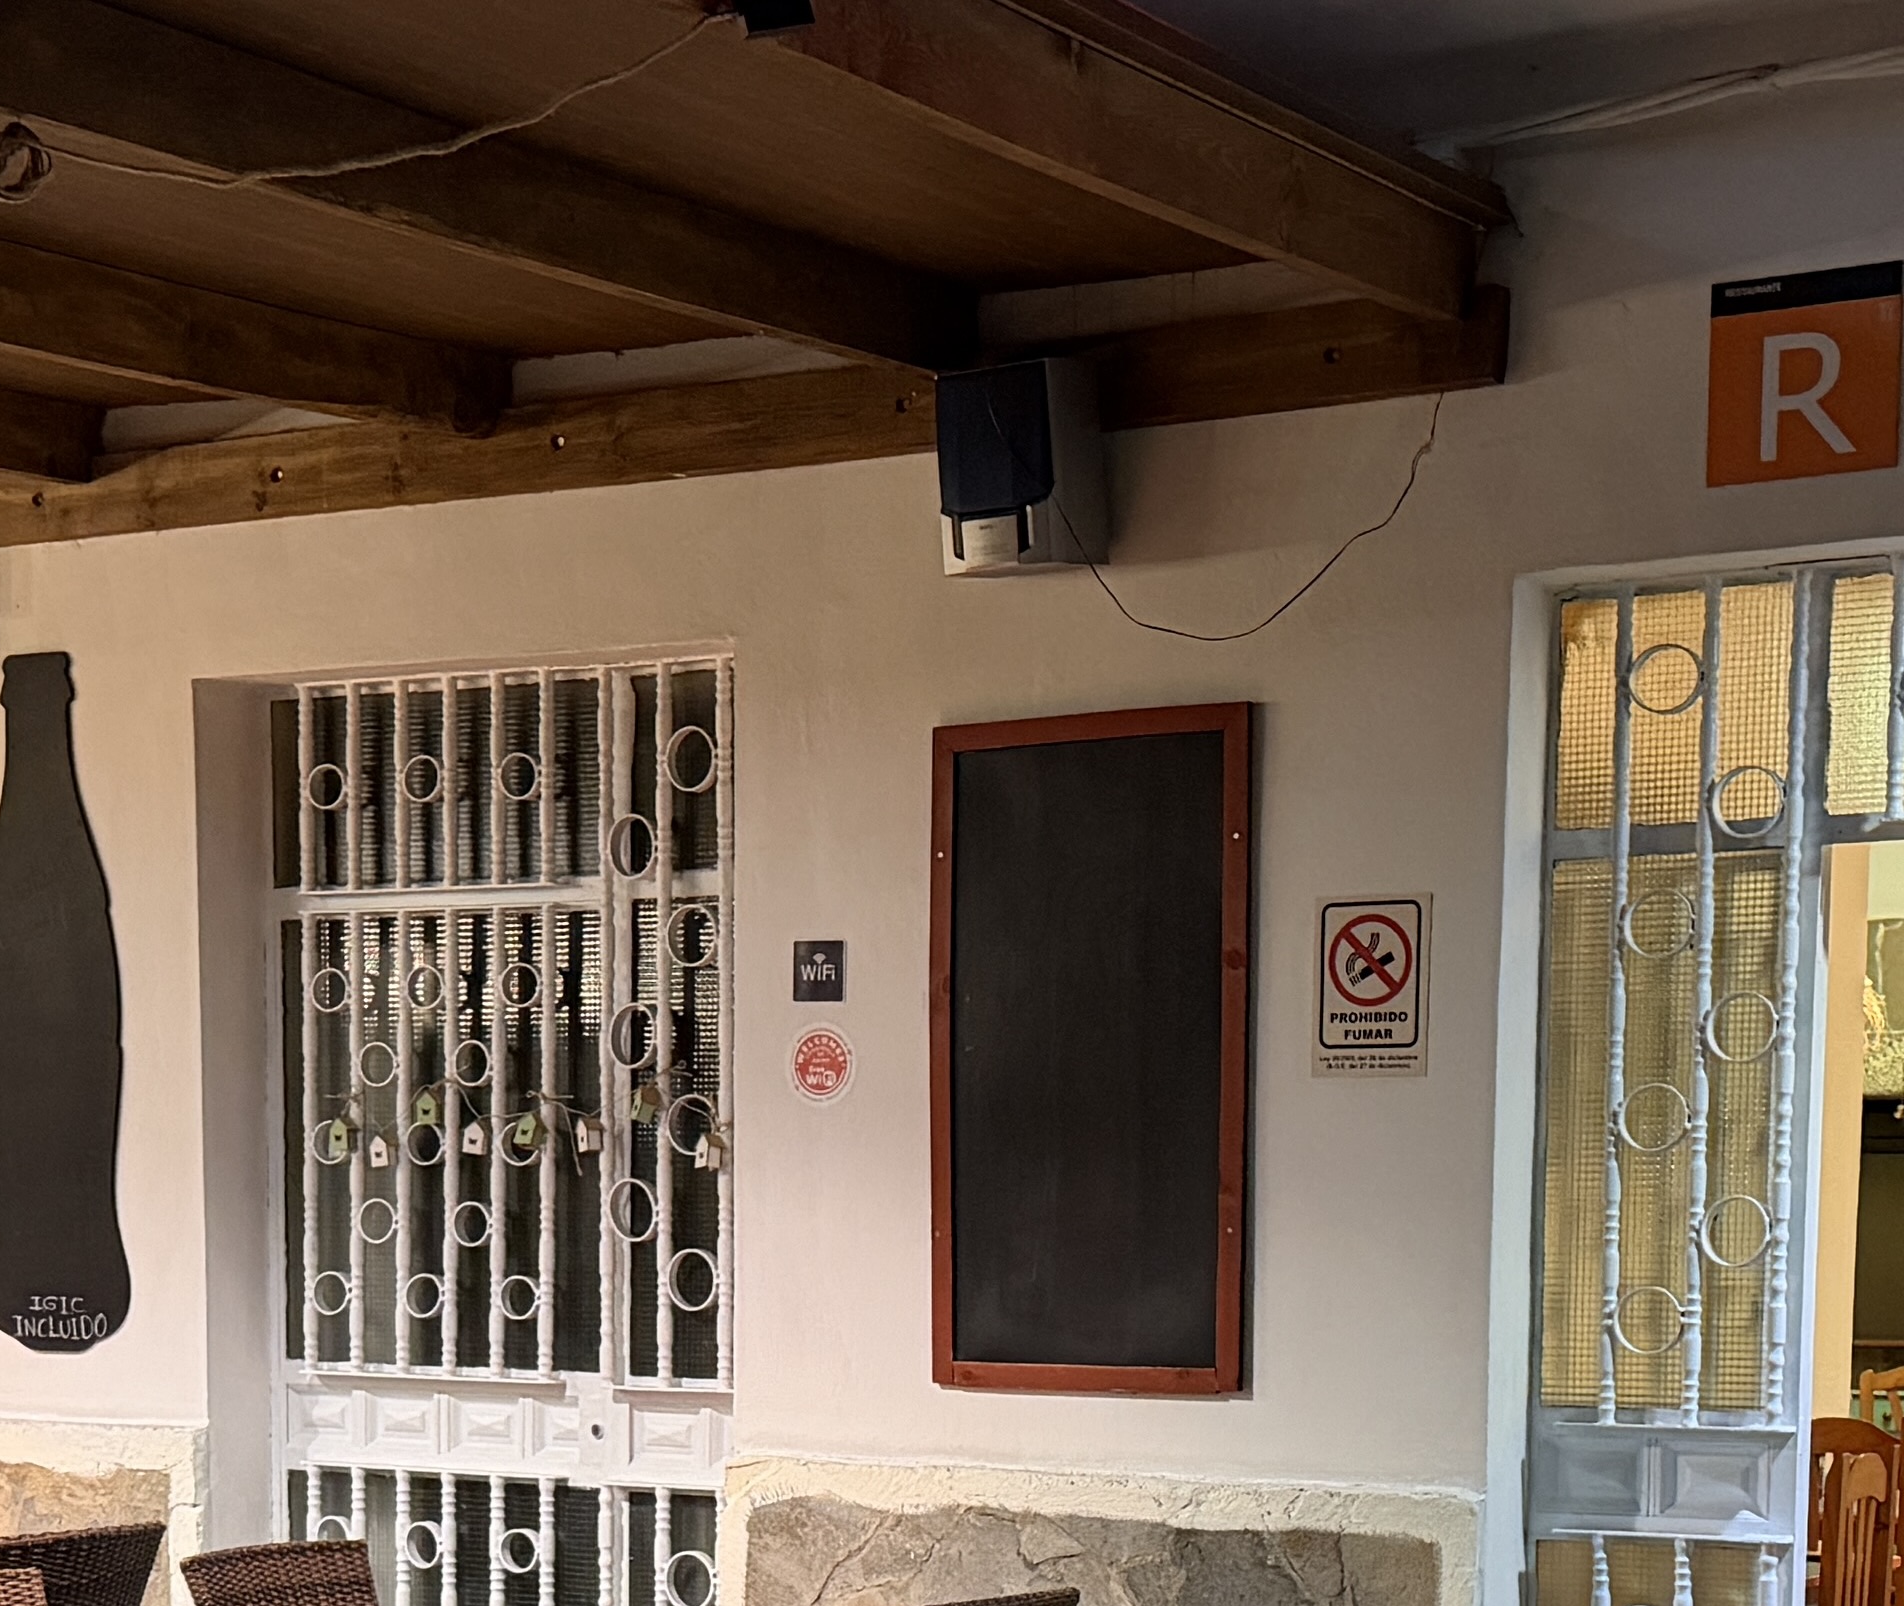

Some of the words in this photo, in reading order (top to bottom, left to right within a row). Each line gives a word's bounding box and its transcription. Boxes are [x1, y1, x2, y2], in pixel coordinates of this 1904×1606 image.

[1760, 332, 1856, 462] R
[1330, 1011, 1408, 1024] PROHIBIDO
[1344, 1028, 1393, 1041] FUMAR
[28, 1296, 86, 1315] IGIC
[12, 1313, 108, 1340] INCLUIDO
